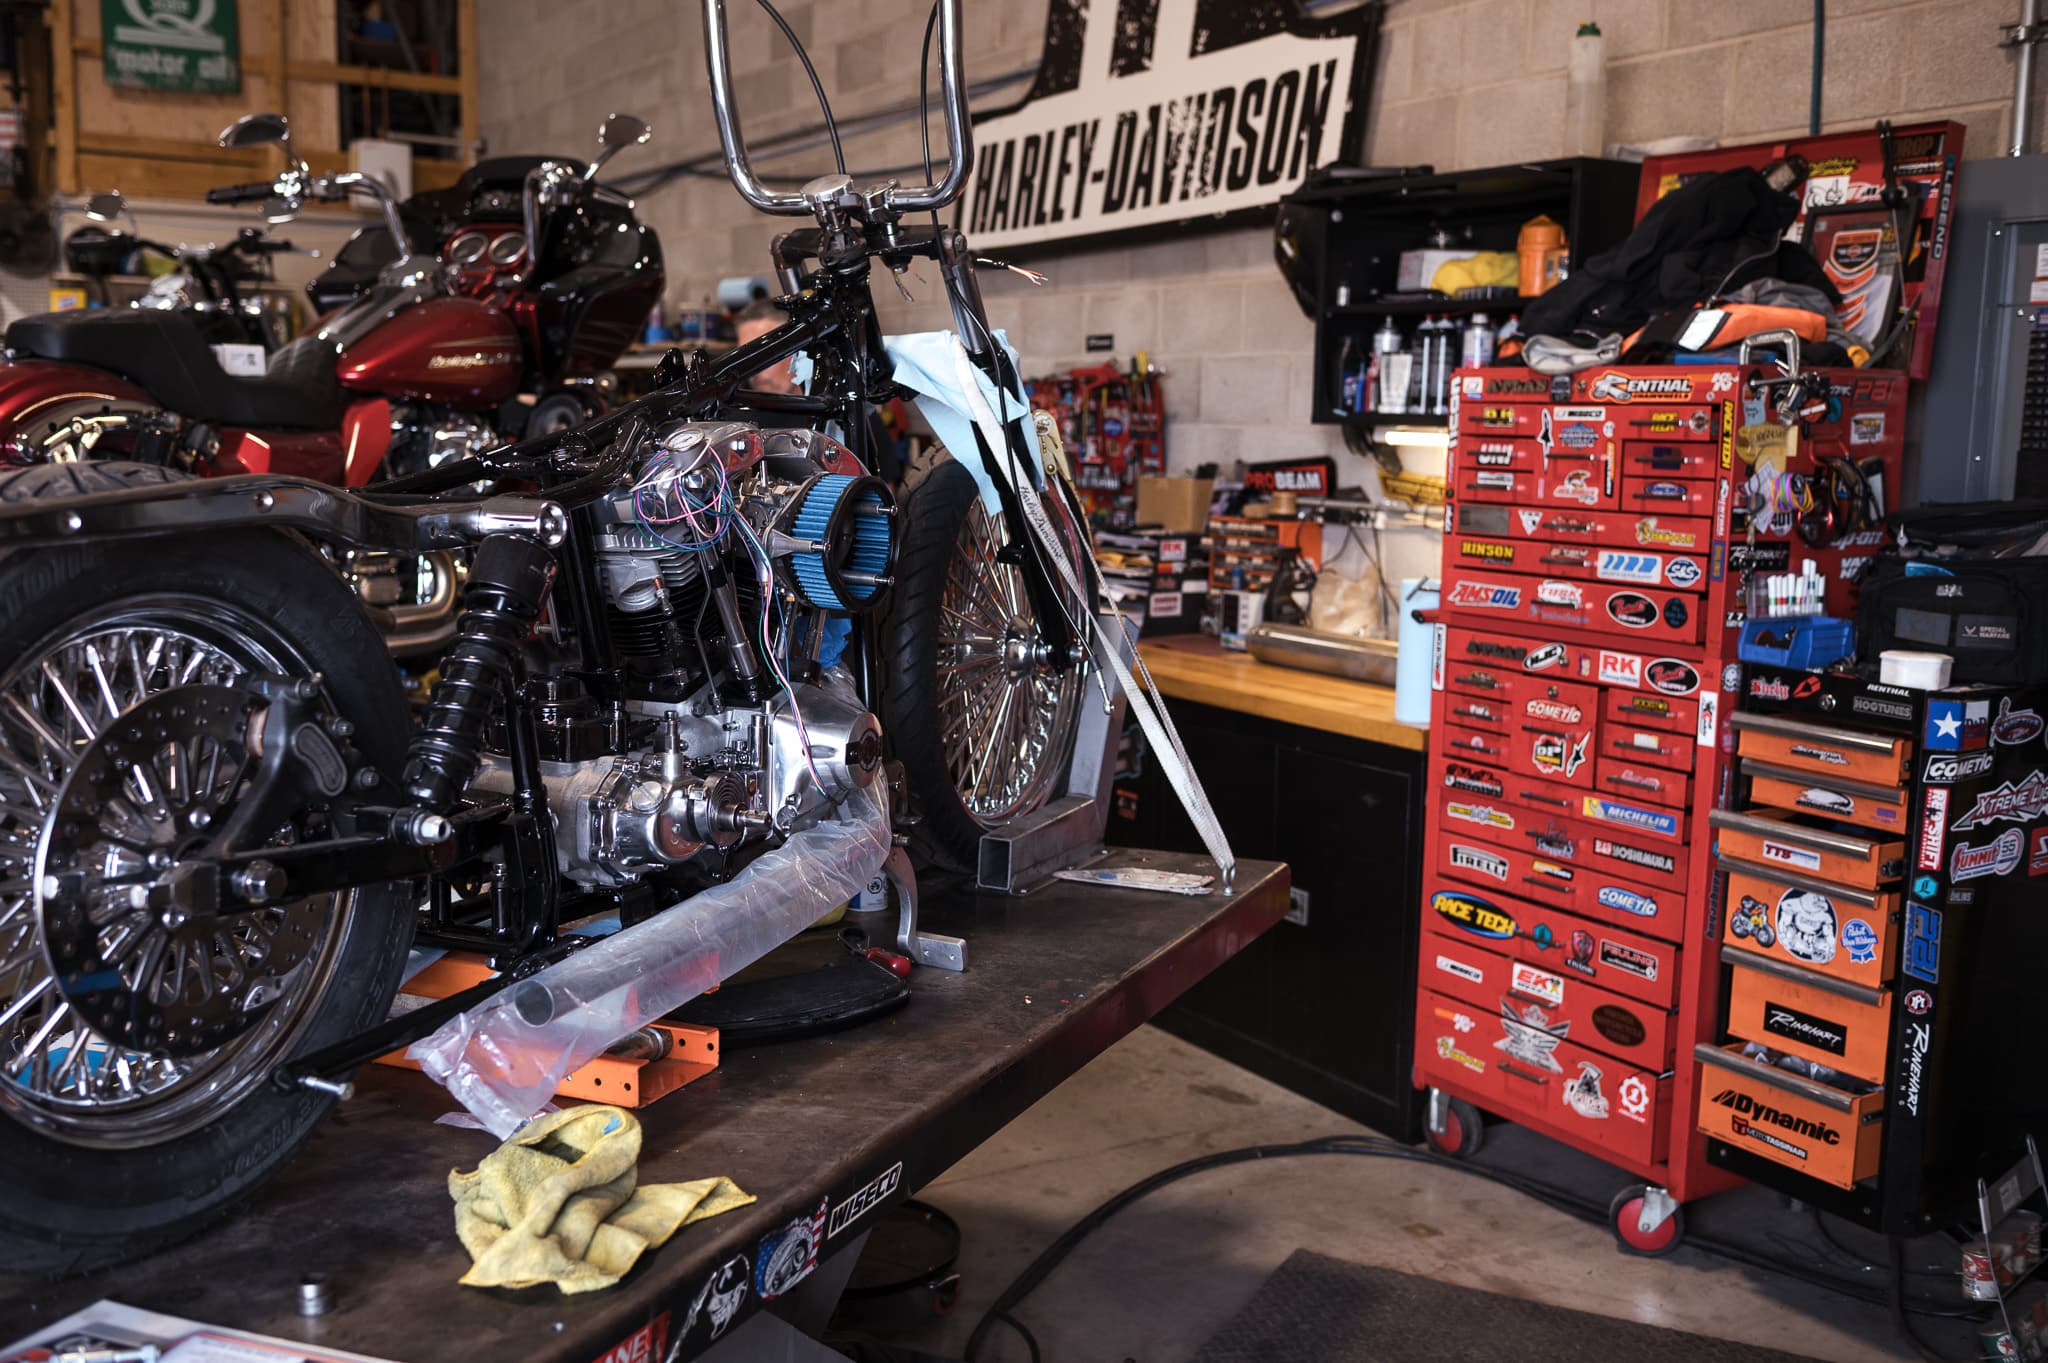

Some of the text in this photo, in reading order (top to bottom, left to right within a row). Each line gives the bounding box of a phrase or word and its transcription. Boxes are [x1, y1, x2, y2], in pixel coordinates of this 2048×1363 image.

[116, 49, 228, 79] motor oil
[969, 58, 1338, 234] HARLEY-DAVIDSON
[1934, 171, 1954, 259] LEGEND
[1462, 542, 1514, 558] HINSON
[1671, 563, 1695, 580] S&S
[1453, 583, 1518, 607] AMSOIL
[1602, 655, 1636, 676] RK
[1867, 684, 1910, 697] RENTHAL
[1527, 699, 1582, 723] COMETIC
[1854, 700, 1911, 717] HOGTUNES
[1929, 753, 1993, 777] COMETIC
[1976, 790, 2030, 816] XTREME
[1608, 806, 1670, 828] MICHELIN
[1452, 846, 1507, 878] PIRELLI
[1613, 845, 1674, 871] YOSHIMURA
[1765, 843, 1792, 860] TTS
[1953, 846, 1998, 876] SUMMIT
[1599, 887, 1657, 916] COMETIC
[1434, 895, 1516, 936] RACE TECH
[1911, 906, 1939, 983] PBI
[1517, 969, 1548, 990] EK
[1770, 1009, 1842, 1046] RINEHART
[1899, 1027, 1913, 1106] RACING
[1907, 1023, 1930, 1117] RINEHART
[1735, 1093, 1841, 1146] Dynamic
[832, 1167, 899, 1231] WISECO
